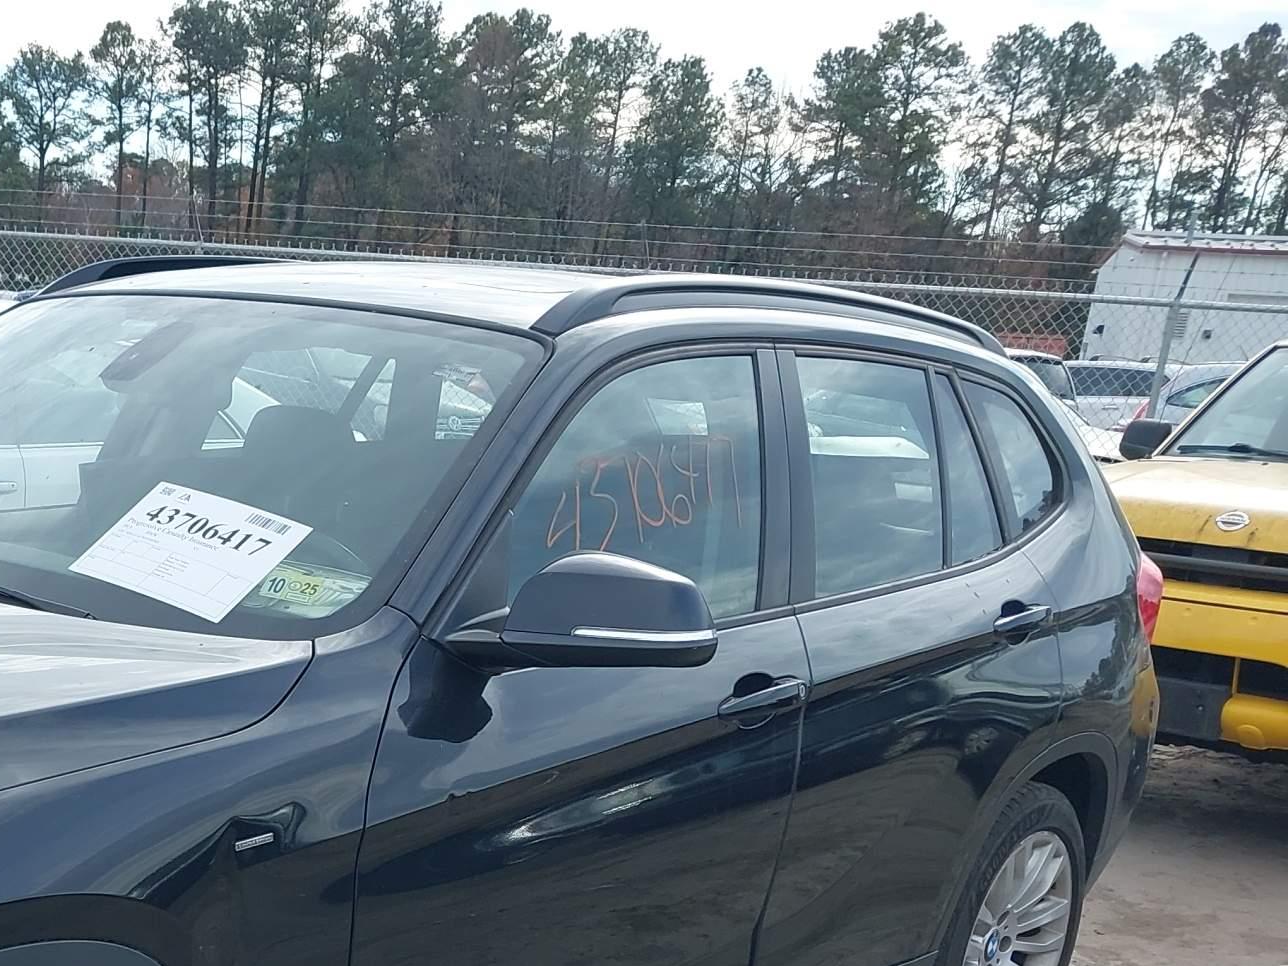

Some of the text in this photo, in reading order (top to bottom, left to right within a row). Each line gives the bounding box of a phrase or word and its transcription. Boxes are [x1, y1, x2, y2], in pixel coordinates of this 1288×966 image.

[145, 505, 273, 556] 43706417
[268, 578, 320, 596] 10 25
